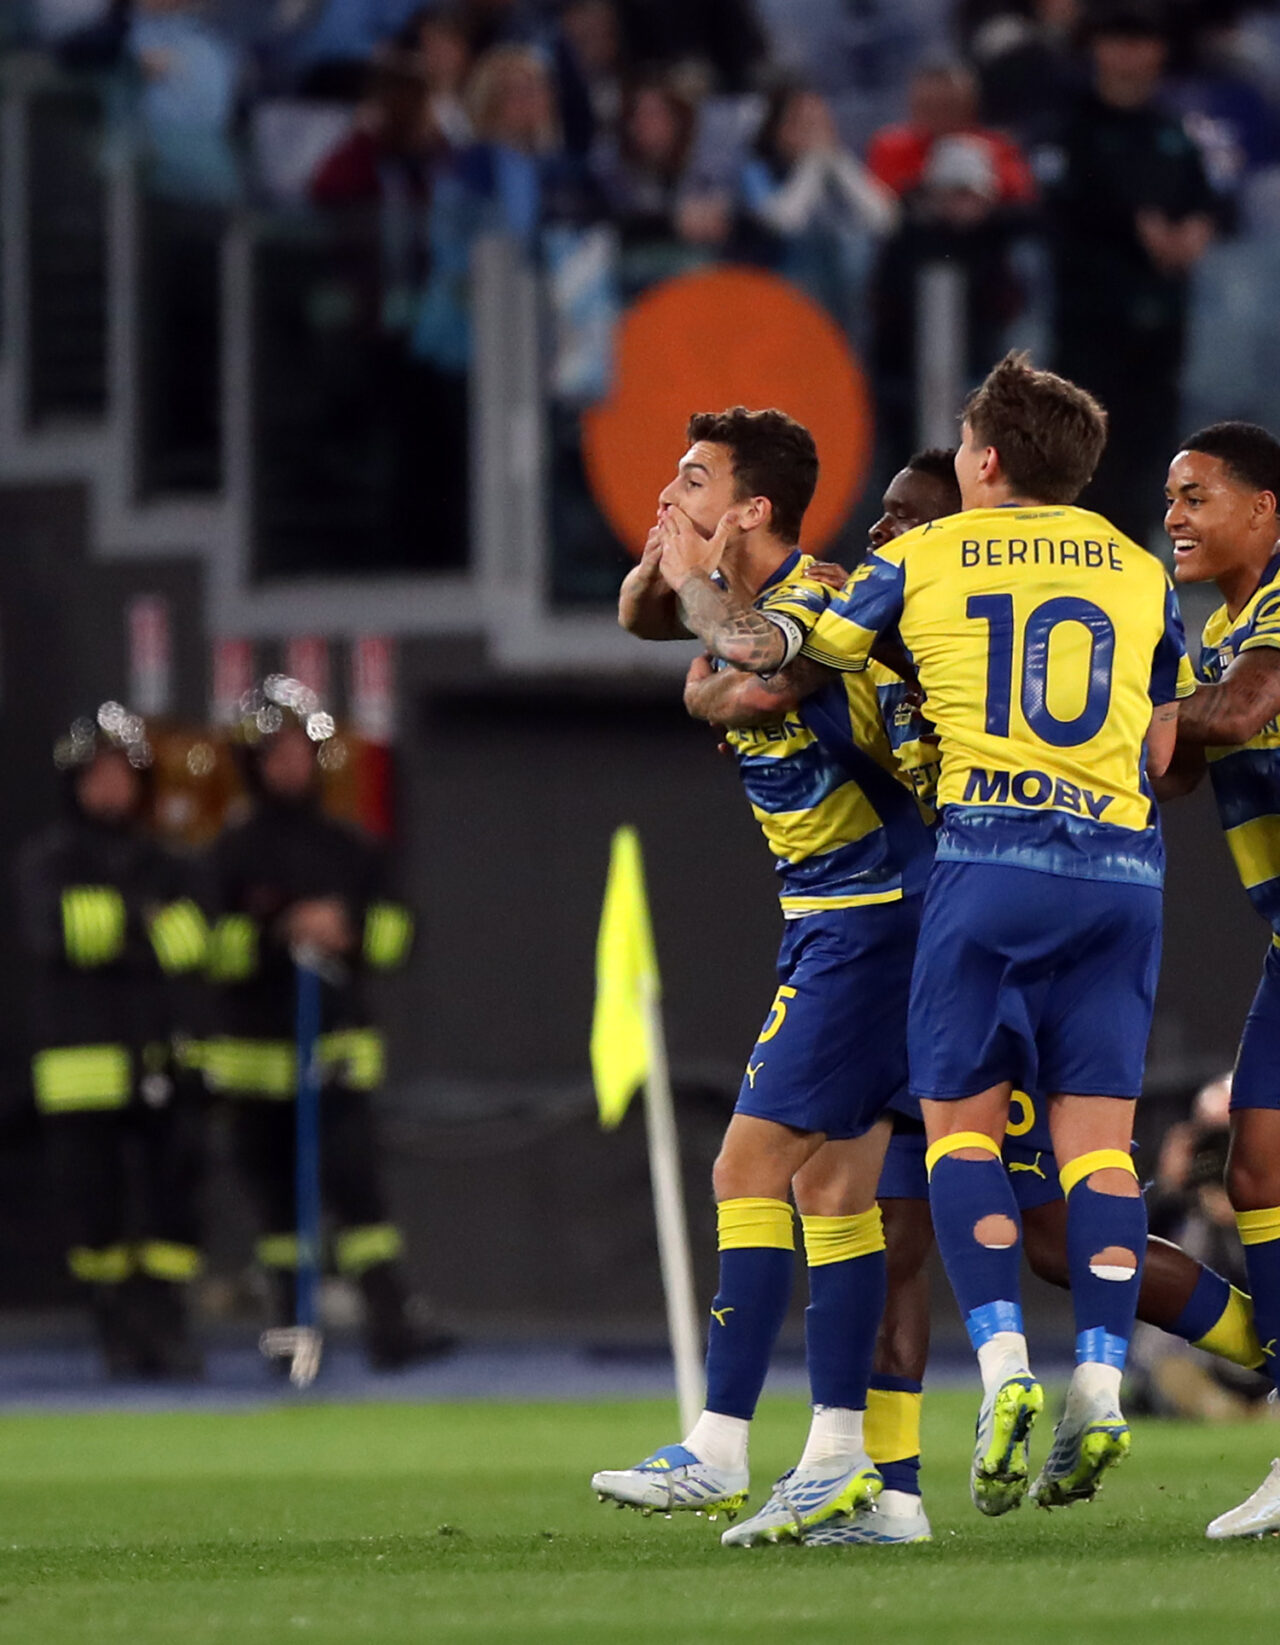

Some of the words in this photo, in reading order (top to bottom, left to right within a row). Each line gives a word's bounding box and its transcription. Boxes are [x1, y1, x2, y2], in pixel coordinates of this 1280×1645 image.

[961, 537, 1123, 572] BERNABÉ
[966, 593, 1116, 748] 10
[963, 768, 1115, 820] MOBY
